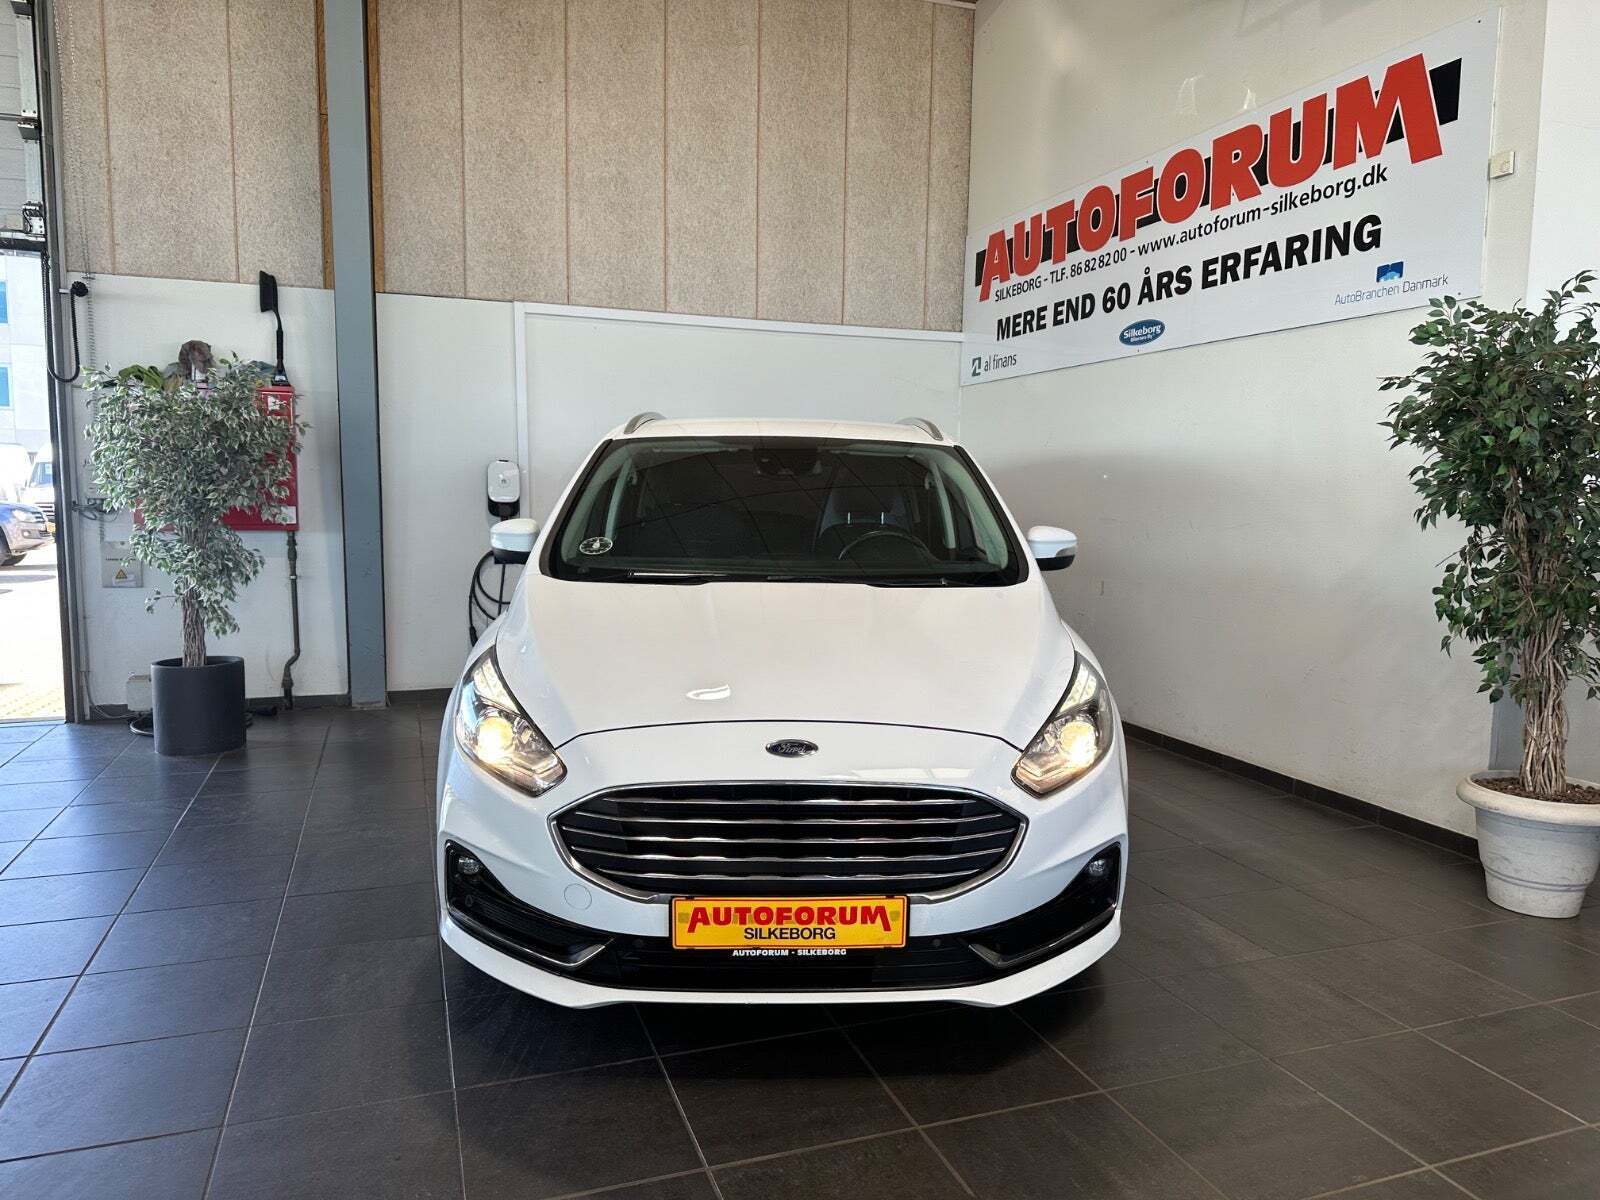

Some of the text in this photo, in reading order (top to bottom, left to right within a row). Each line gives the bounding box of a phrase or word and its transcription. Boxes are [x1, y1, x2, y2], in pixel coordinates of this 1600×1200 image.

[979, 53, 1442, 302] AUTOFORUM
[995, 275, 1042, 302] SILKEBORG
[1050, 267, 1069, 285] TLF.
[1138, 163, 1388, 255] www.autoforum-silkeborg.dk
[997, 214, 1382, 342] MERE END 60 ÅRS ERFARING
[1334, 274, 1449, 305] AutoBranchen Danmark
[1123, 324, 1161, 339] Silkeborg
[984, 353, 1017, 372] al finans
[779, 743, 807, 753] Ford
[687, 905, 892, 933] AUTOFORUM
[744, 927, 837, 940] SILKEBORG
[732, 949, 789, 957] AUTOFORUM
[797, 948, 847, 956] SILKEBORG
